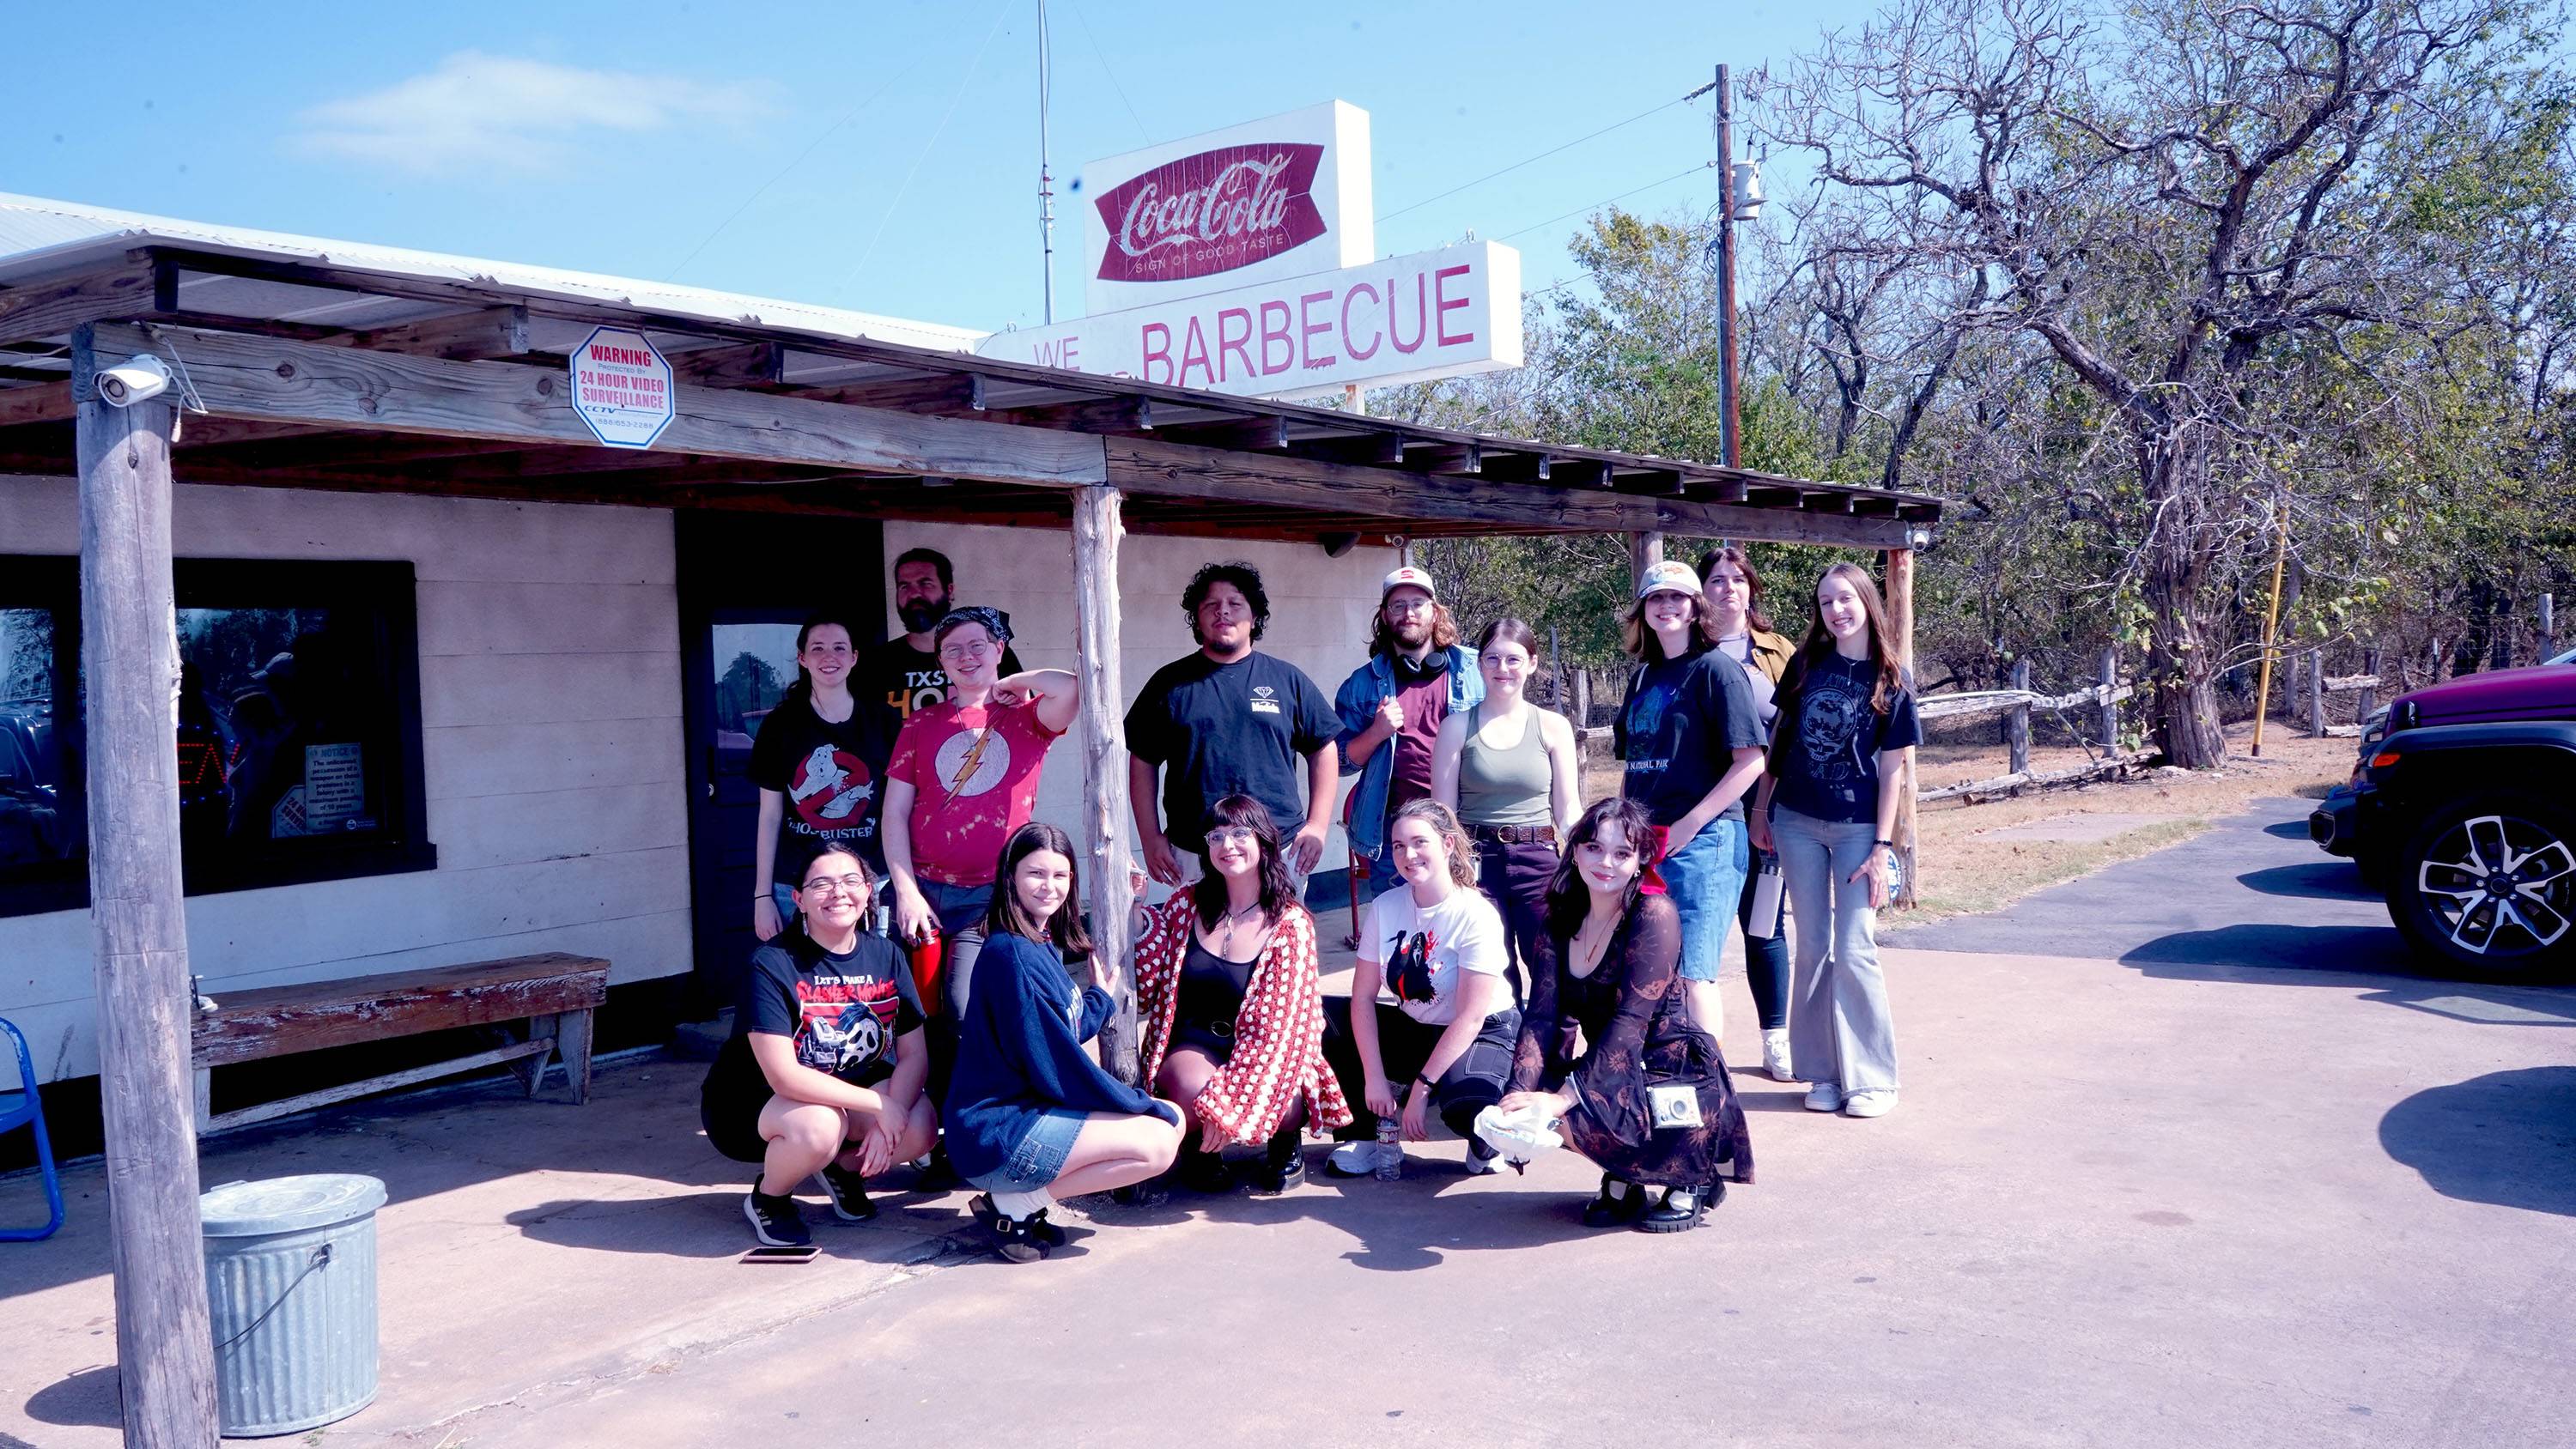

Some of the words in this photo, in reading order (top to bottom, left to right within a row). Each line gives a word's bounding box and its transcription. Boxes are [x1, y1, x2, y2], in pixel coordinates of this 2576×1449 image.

[1135, 258, 1166, 273] SIGN
[1172, 254, 1188, 266] OF
[1195, 245, 1235, 261] GOOD
[1242, 233, 1284, 252] TASTE
[1141, 263, 1475, 388] BARBECUE
[590, 343, 652, 367] WARNING
[1033, 336, 1080, 371] WE
[580, 370, 594, 385] 24
[597, 372, 629, 389] HOUR
[630, 376, 665, 393] VIDEO
[582, 387, 665, 409] SURVEILLANCE
[584, 405, 616, 414] CCTV
[905, 670, 952, 688] TXS
[814, 975, 841, 985] LET'S
[842, 975, 866, 985] MAKE
[866, 974, 874, 985] A
